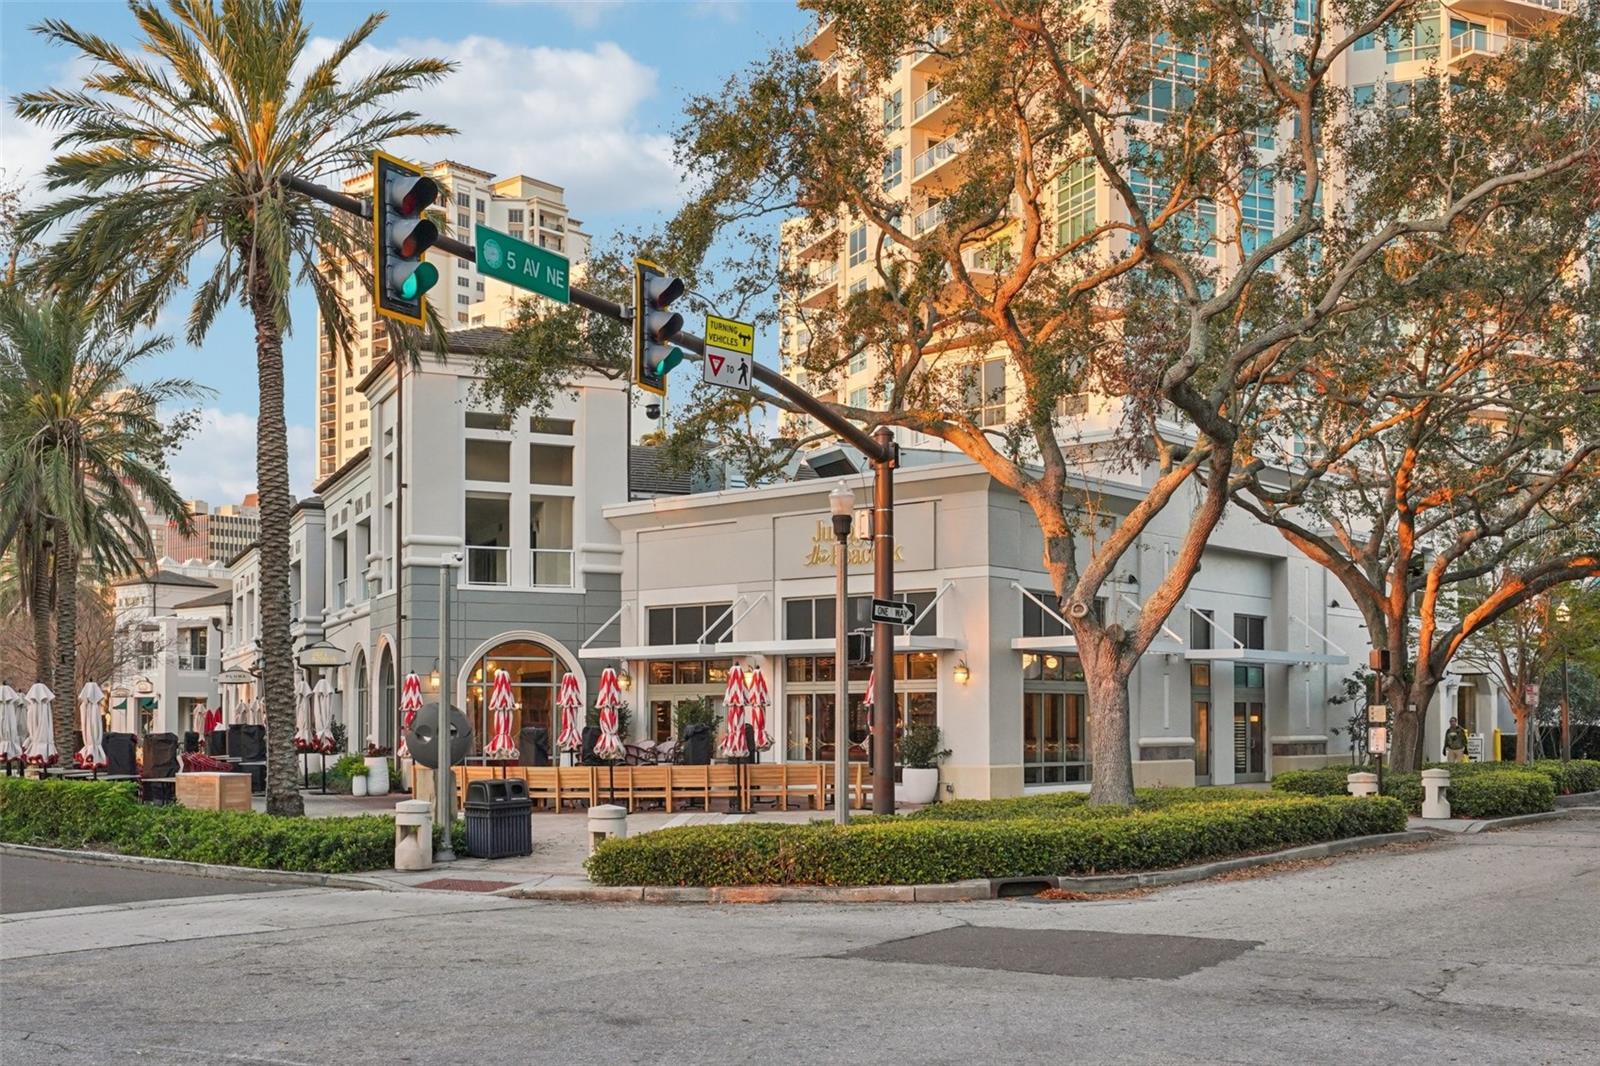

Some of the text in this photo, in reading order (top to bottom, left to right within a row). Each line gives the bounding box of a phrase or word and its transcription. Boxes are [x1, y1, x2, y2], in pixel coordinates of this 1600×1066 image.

[506, 250, 516, 270] 5
[523, 258, 541, 278] AV
[546, 265, 565, 288] NE
[710, 320, 738, 335] TURNING
[708, 332, 738, 347] VEHICLES
[726, 364, 735, 374] TO
[877, 606, 908, 618] ONE WAY
